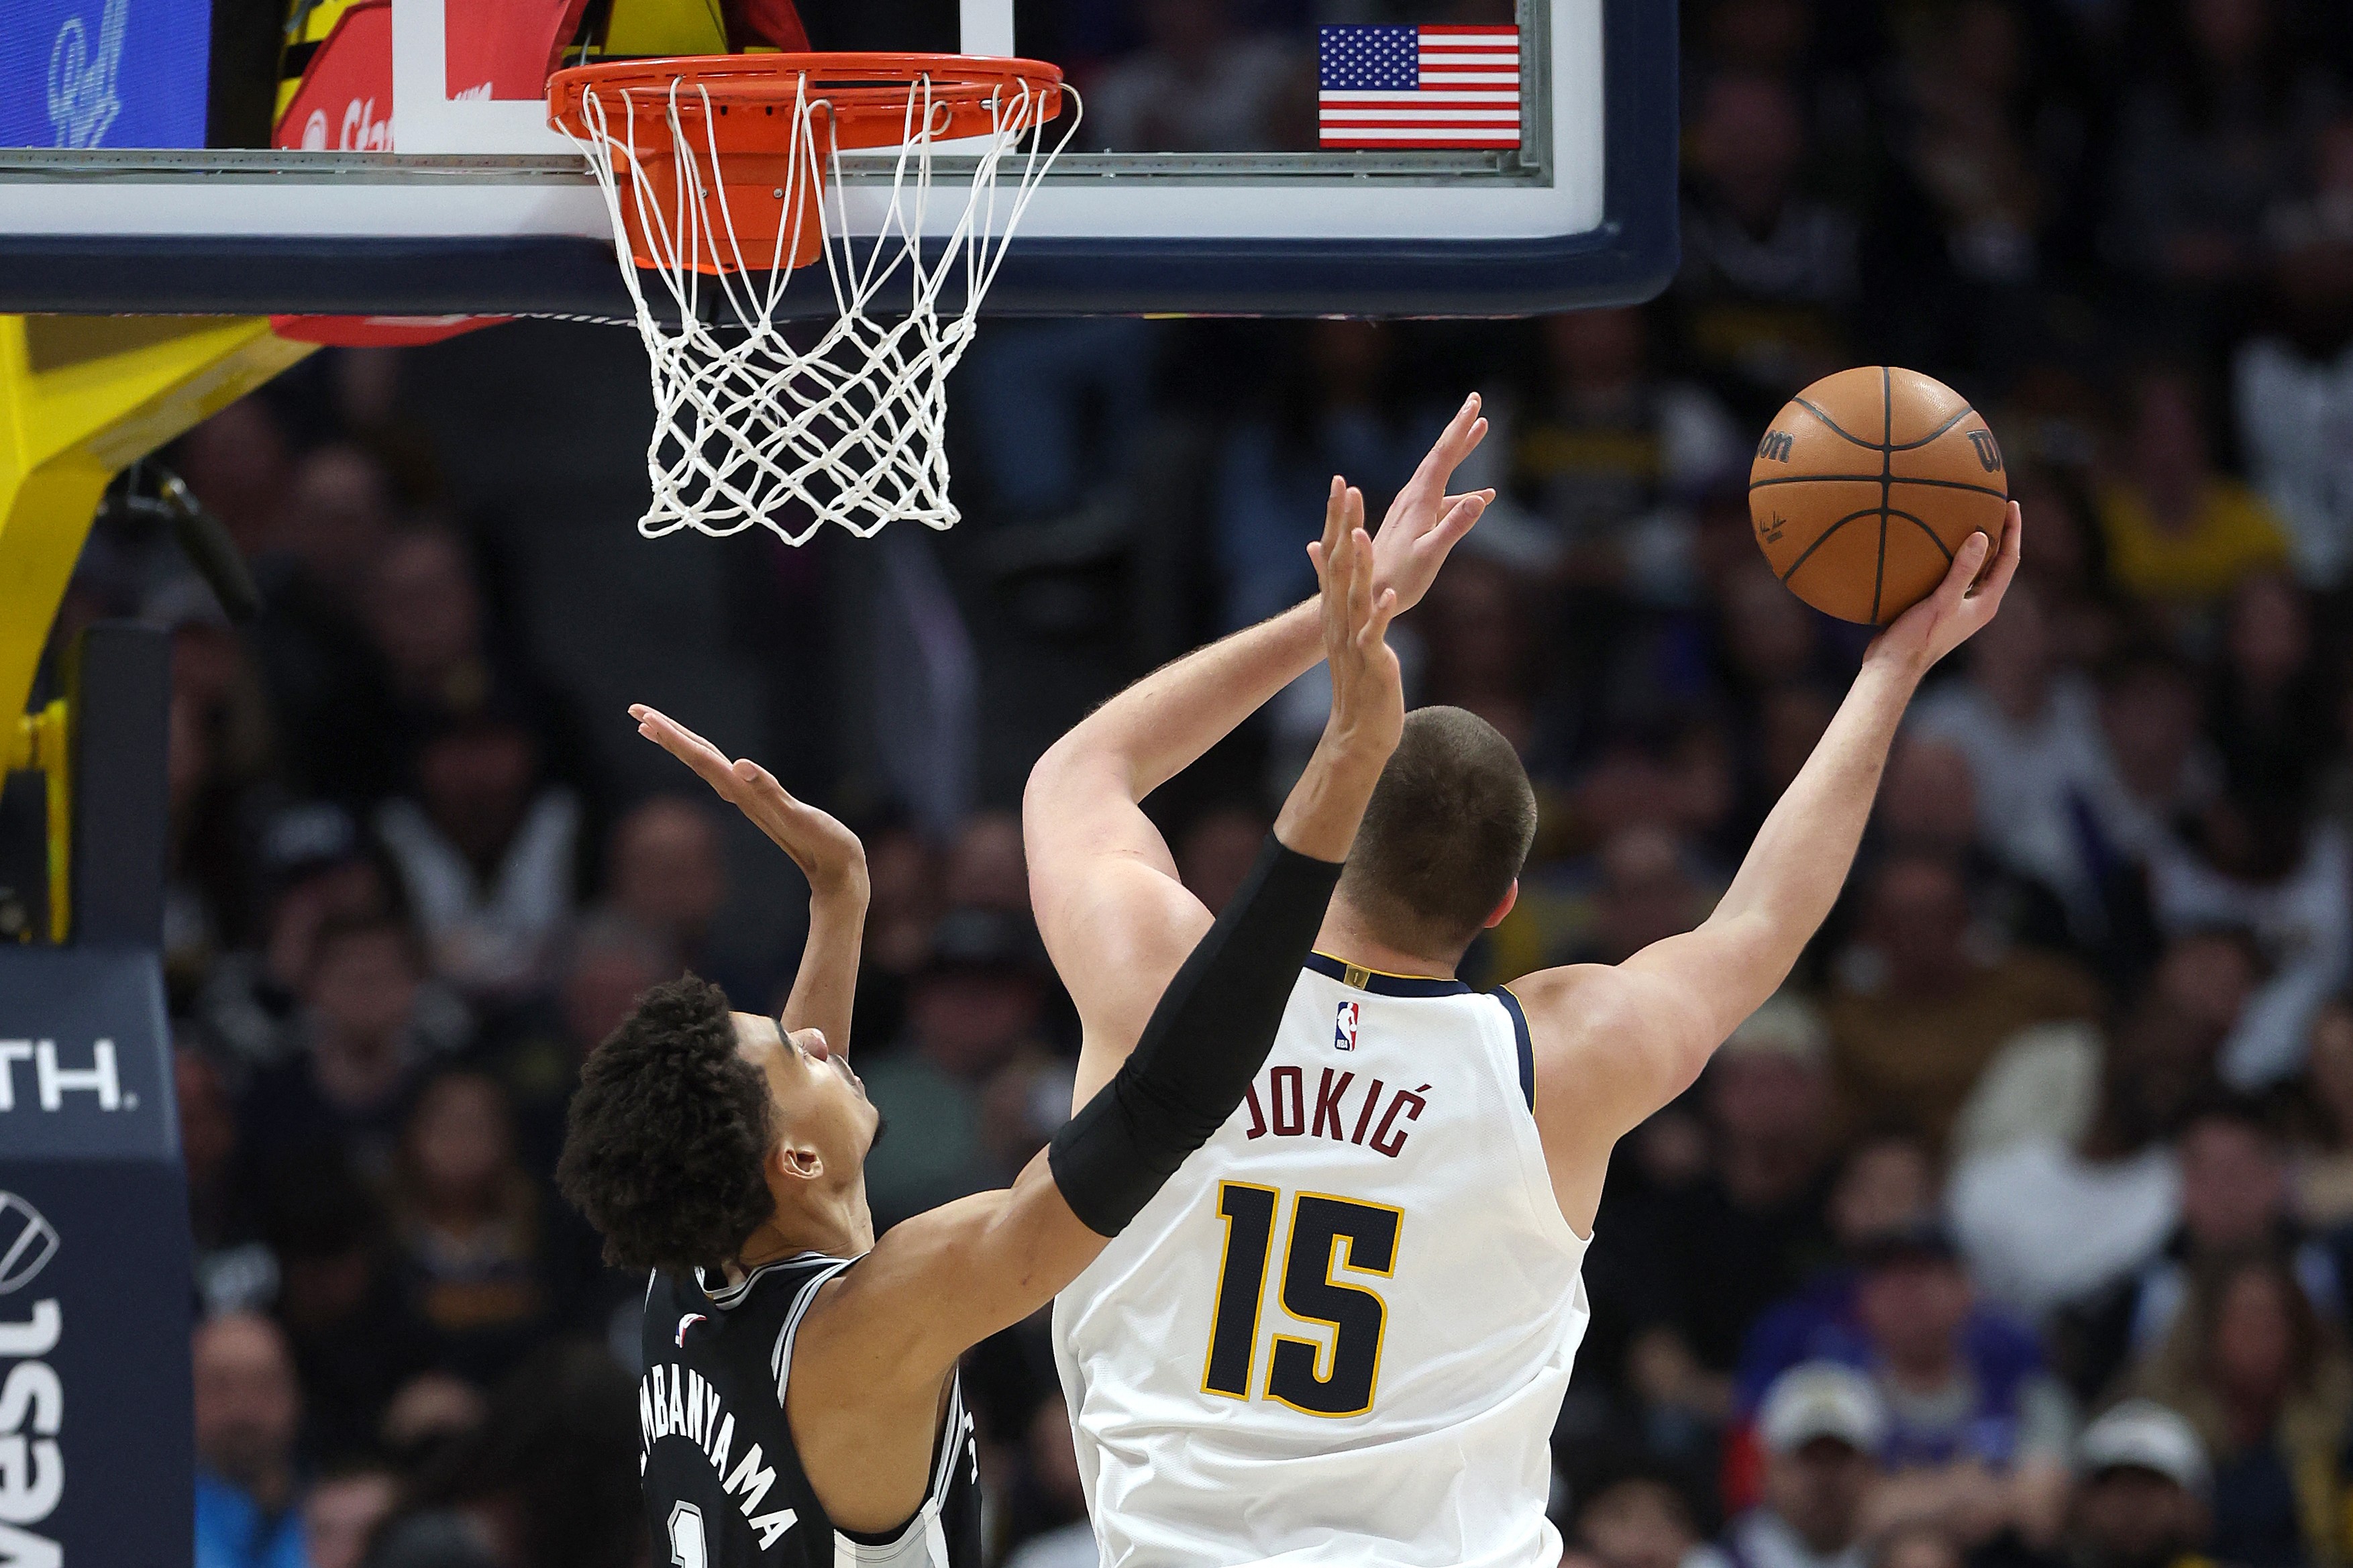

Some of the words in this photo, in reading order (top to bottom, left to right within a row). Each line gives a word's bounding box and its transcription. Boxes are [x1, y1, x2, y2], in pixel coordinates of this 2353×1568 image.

[1245, 1065, 1432, 1158] JOKIĆ
[1336, 1039, 1348, 1049] NBA
[1200, 1179, 1405, 1419] 15
[638, 1363, 798, 1551] MBANYAMA
